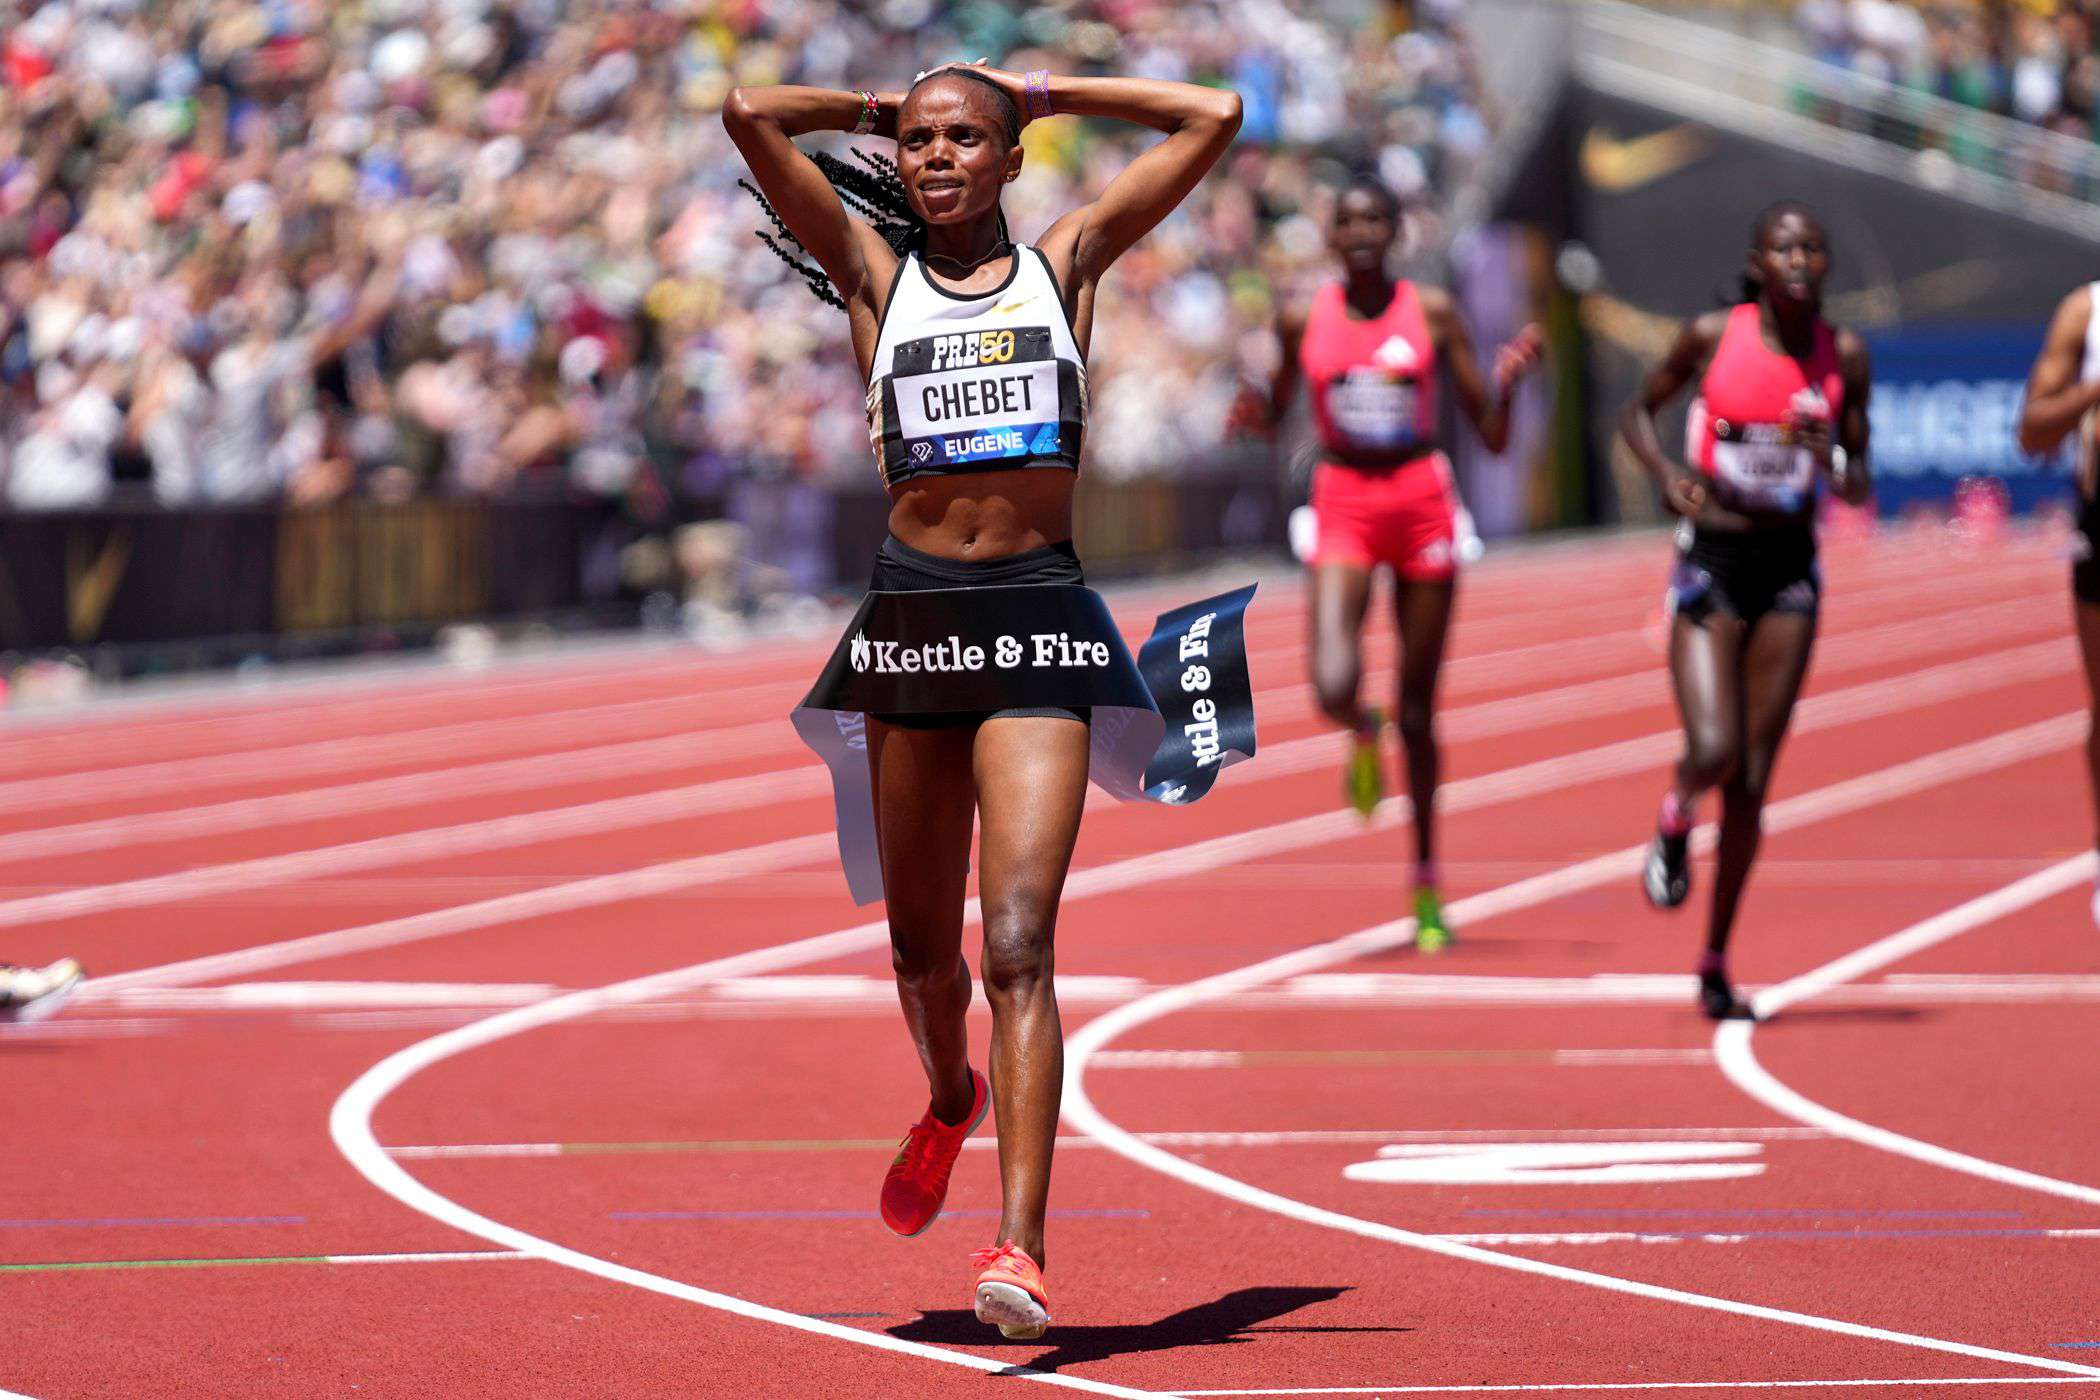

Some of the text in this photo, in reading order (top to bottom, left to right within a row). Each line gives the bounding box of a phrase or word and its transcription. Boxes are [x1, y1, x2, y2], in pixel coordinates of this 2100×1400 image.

[922, 374, 1034, 422] CHEBET
[945, 431, 1023, 457] EUGENE
[874, 632, 1110, 673] Kettle & Fire
[1181, 665, 1211, 692] &
